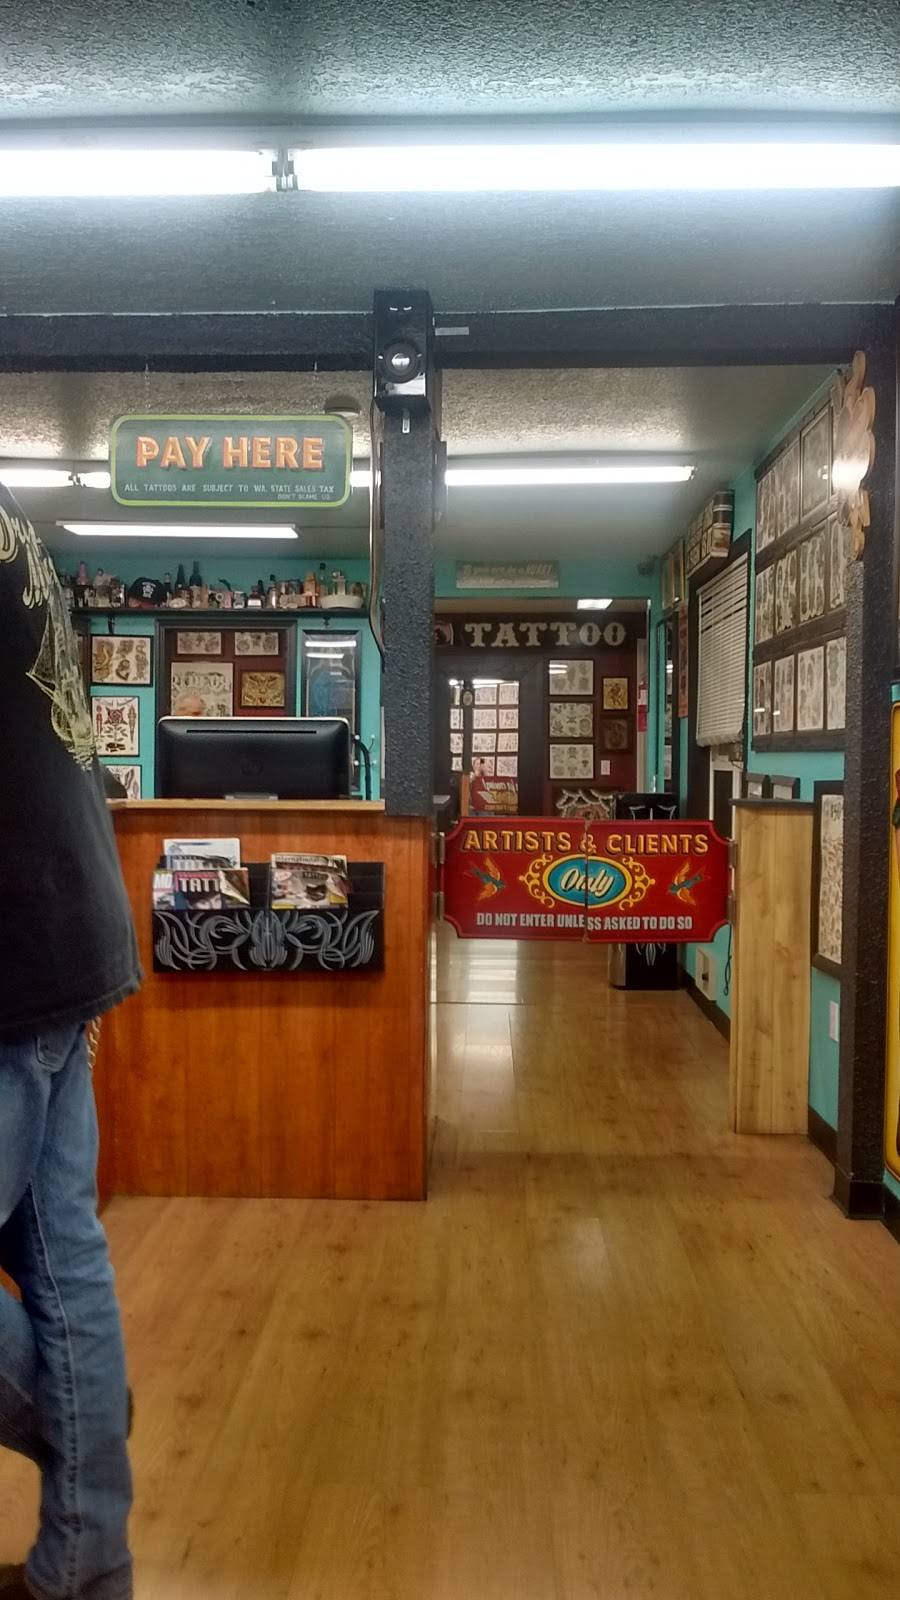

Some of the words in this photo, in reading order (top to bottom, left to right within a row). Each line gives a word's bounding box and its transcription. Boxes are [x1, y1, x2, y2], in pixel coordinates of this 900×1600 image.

[136, 436, 212, 469] PAY
[223, 436, 325, 471] HERE
[124, 483, 139, 492] ALL
[143, 483, 177, 493] TATTOOS
[181, 483, 196, 493] ARE
[203, 484, 233, 493] SUBJECT
[238, 484, 249, 493] TO
[270, 484, 291, 493] STATE
[294, 484, 316, 494] SALES
[319, 485, 335, 494] TAX
[464, 621, 627, 648] TATTOO
[462, 829, 572, 853] ARTISTS
[580, 833, 597, 854] &
[606, 833, 709, 856] CLIENTS
[560, 867, 614, 898] Only
[476, 912, 493, 926] DO
[495, 912, 518, 927] NOT
[519, 913, 555, 927] ENTER
[556, 914, 602, 930] UNLESS
[604, 916, 640, 930] ASKED
[642, 917, 658, 930] TO
[659, 917, 676, 930] DO
[677, 917, 693, 930] SO
